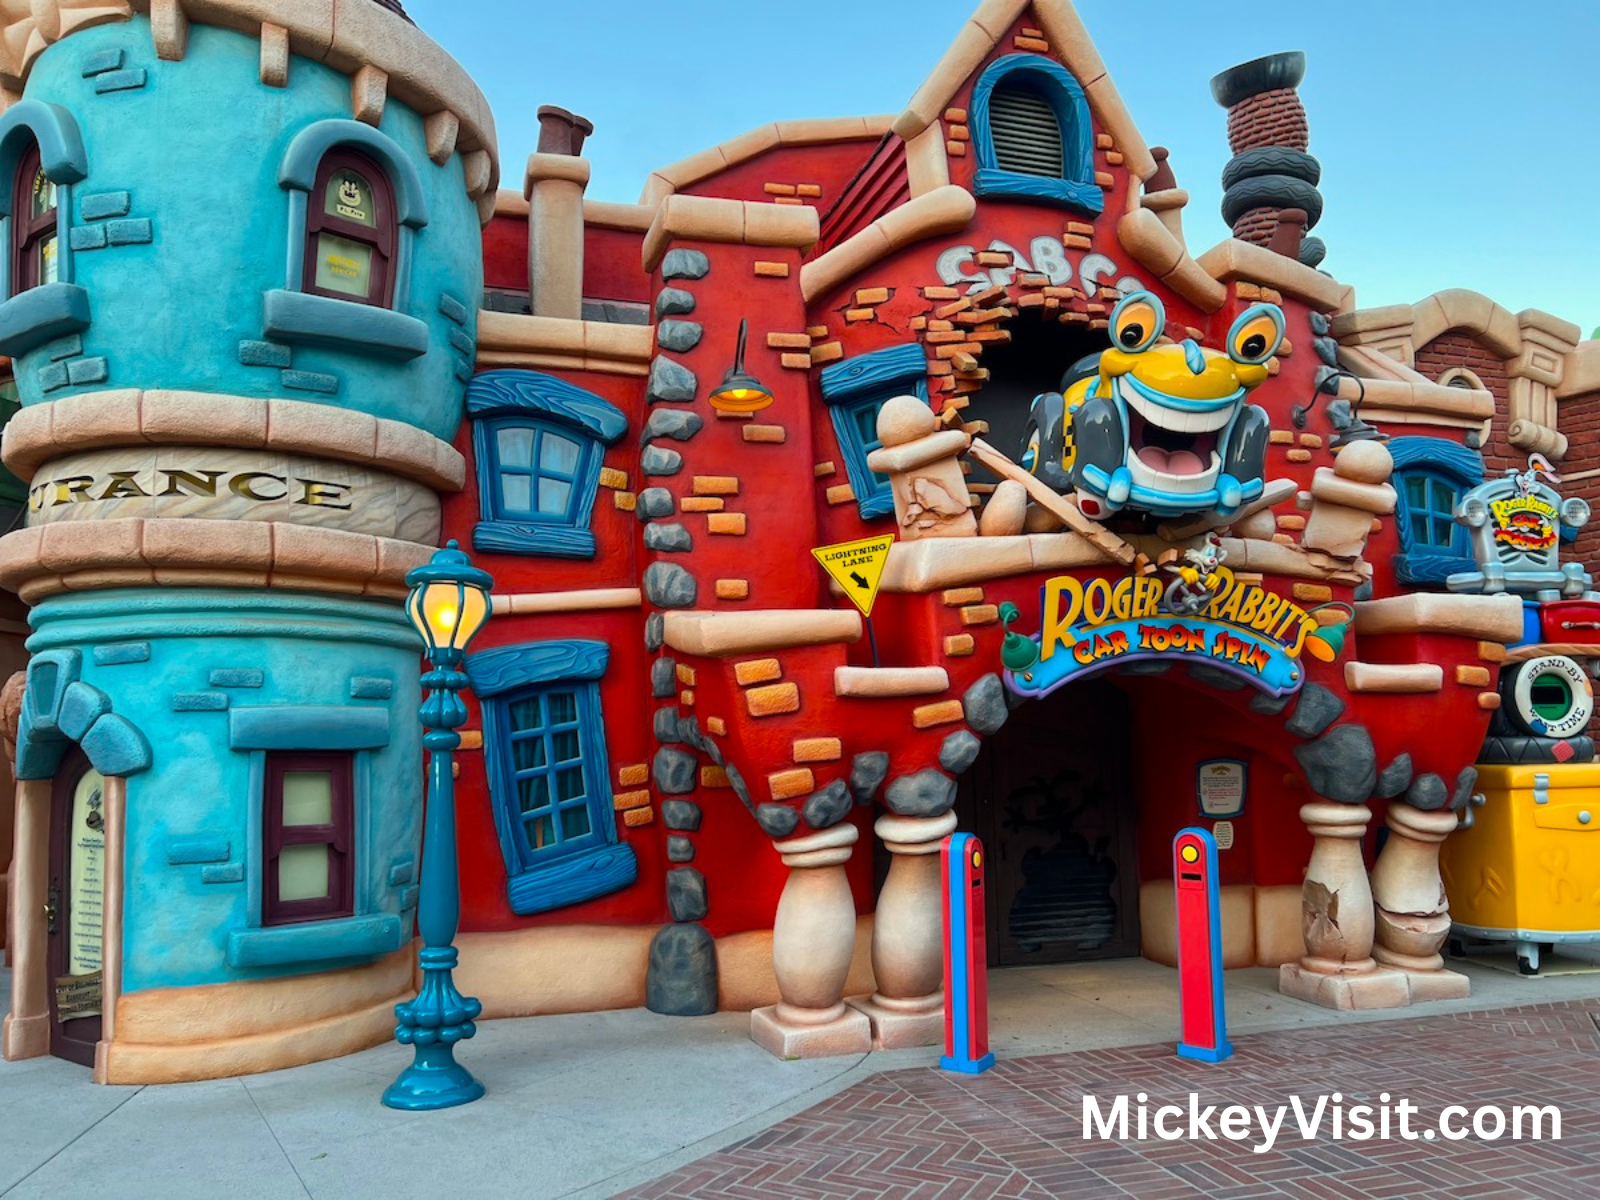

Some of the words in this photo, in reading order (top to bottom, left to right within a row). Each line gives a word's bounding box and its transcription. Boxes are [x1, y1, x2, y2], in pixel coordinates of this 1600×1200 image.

[936, 236, 1073, 296] CAB
[825, 543, 887, 562] LIGHTNING
[842, 555, 873, 568] LANE
[1041, 575, 1164, 663] ROGER
[1200, 564, 1319, 658] RABBIT'S
[1072, 629, 1130, 665] CAR
[1138, 623, 1206, 652] TOON
[1211, 630, 1272, 674] SPIN
[1527, 659, 1584, 684] STAND-BY
[1557, 707, 1586, 732] TIME
